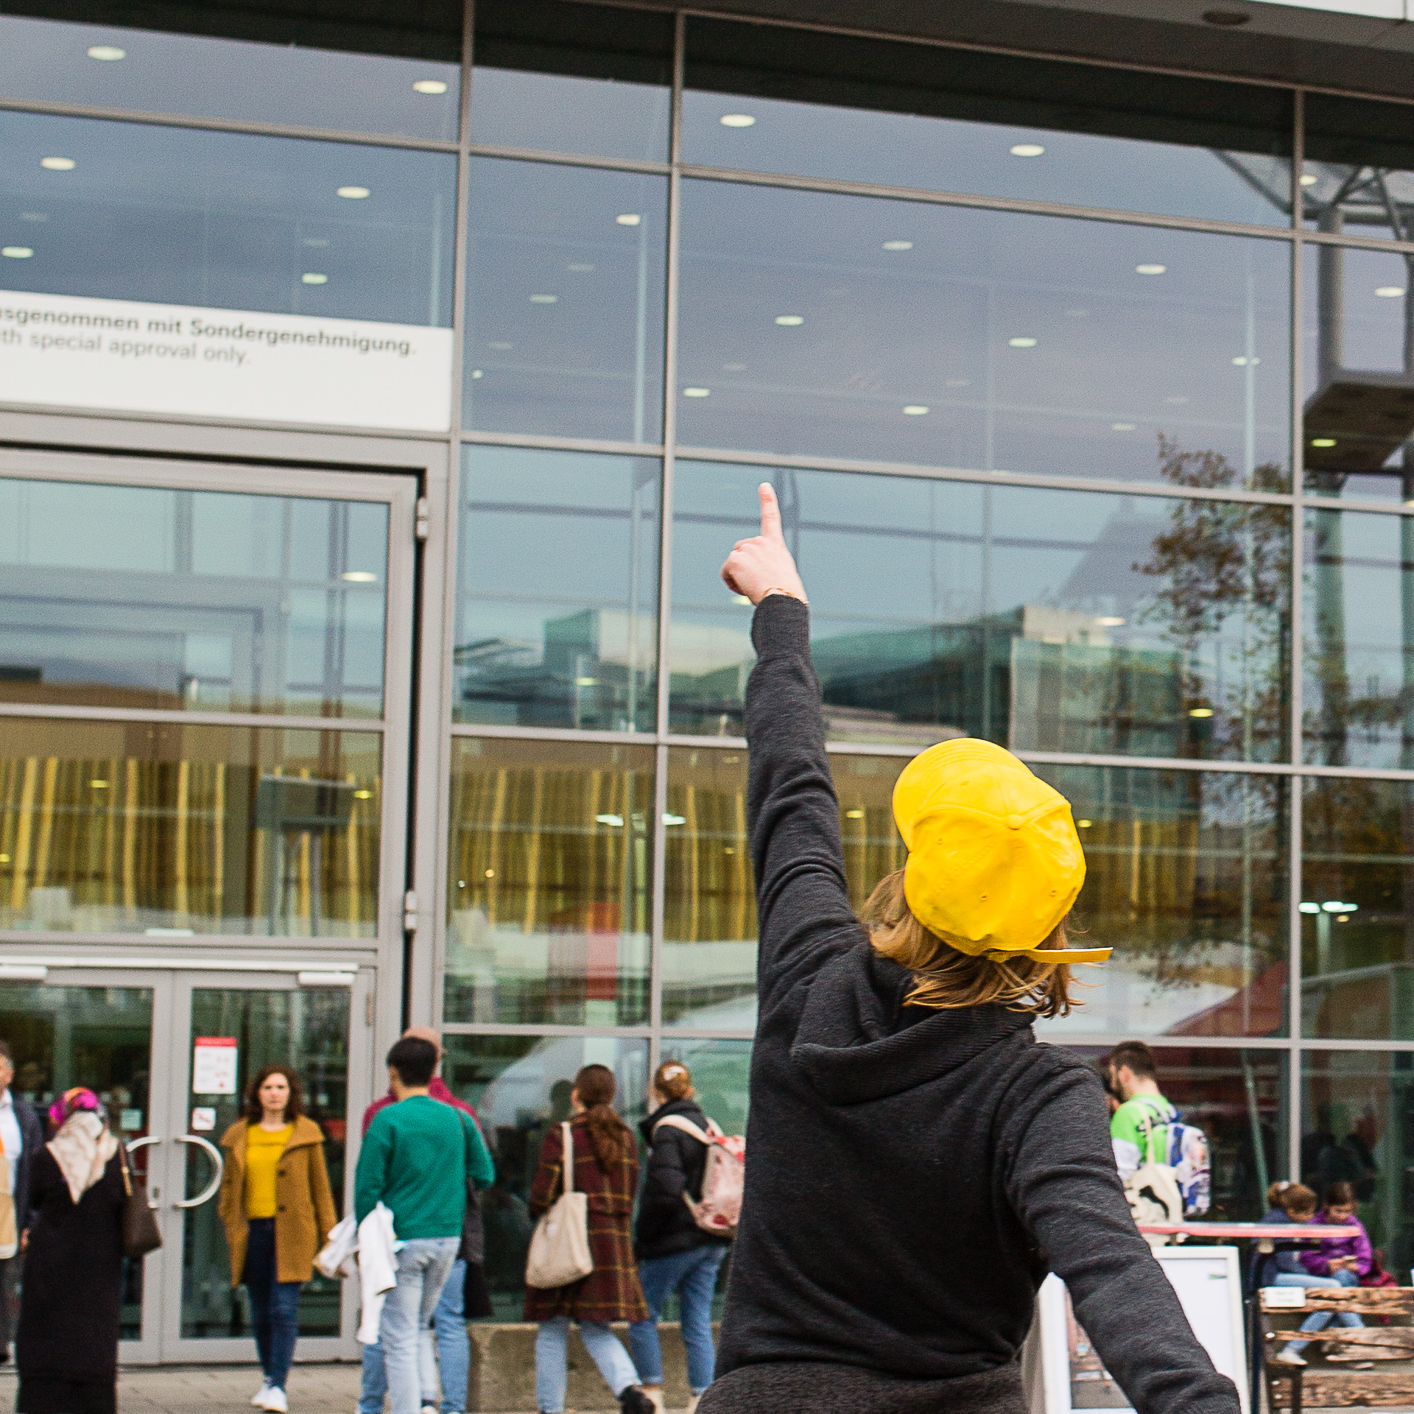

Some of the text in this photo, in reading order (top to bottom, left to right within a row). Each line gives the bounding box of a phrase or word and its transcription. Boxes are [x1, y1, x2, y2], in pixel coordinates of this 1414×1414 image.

[0, 326, 251, 366] th special approval only.
[147, 318, 182, 335] mit
[190, 319, 417, 356] Sondergenehmigung.
